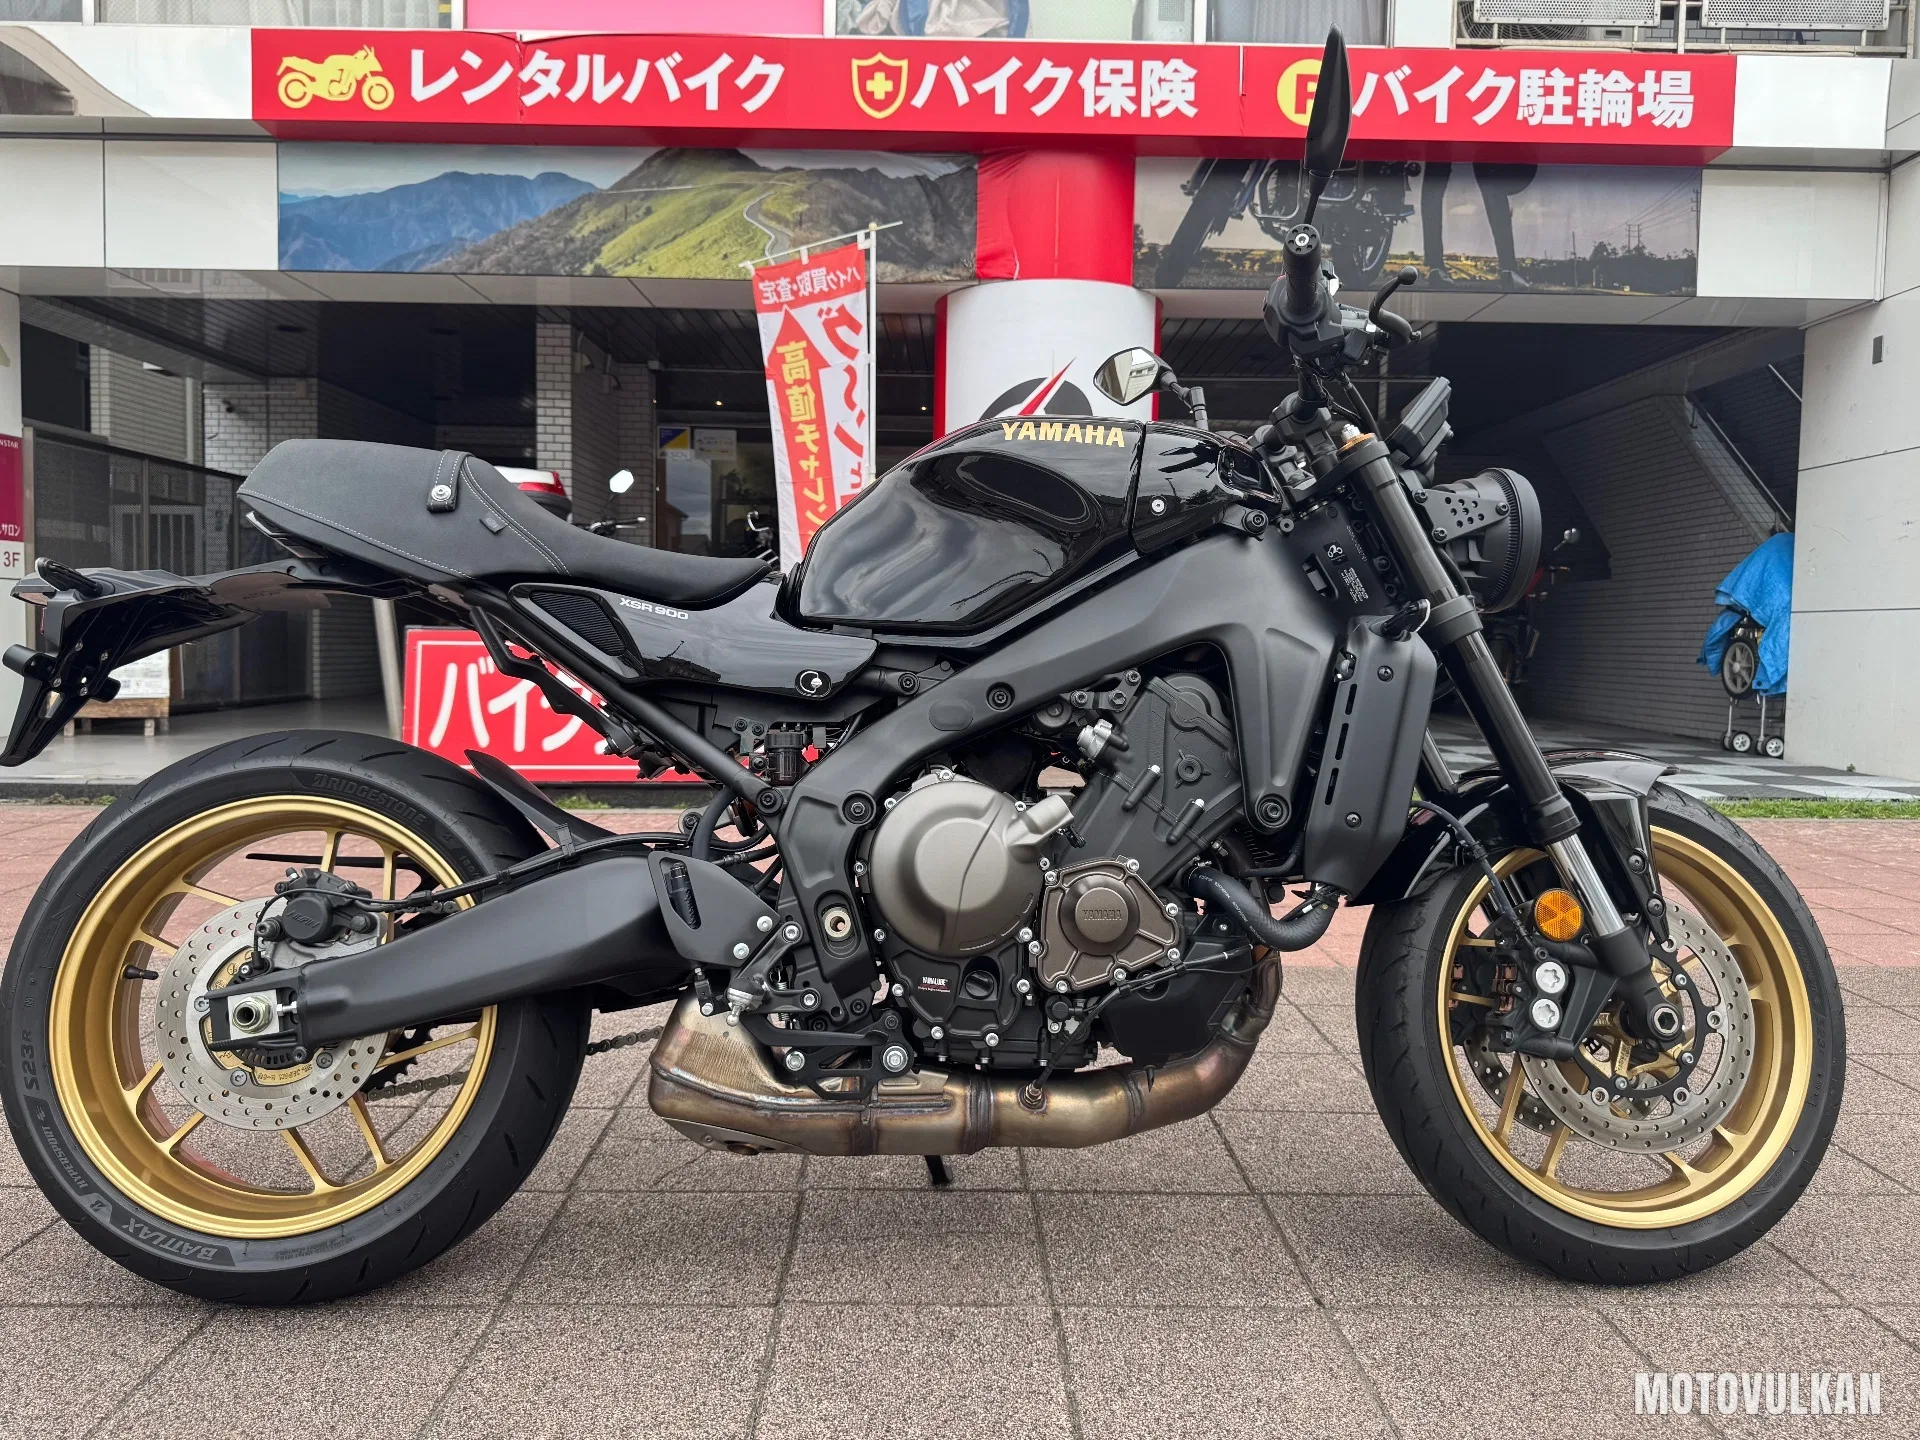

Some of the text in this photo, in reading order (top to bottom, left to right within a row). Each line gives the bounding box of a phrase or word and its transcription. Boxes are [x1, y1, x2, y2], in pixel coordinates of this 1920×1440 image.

[411, 48, 785, 114] レンタルバイク
[910, 55, 1199, 118] バイク保険
[1351, 64, 1694, 129] バイク駐輪場
[1002, 421, 1125, 448] YAMAHA
[3, 551, 20, 567] 3F
[620, 597, 689, 620] XSR 900
[312, 773, 427, 826] BRIDGESTONE
[1083, 909, 1122, 921] YAMAHA
[21, 1030, 218, 1261] BATTLAX HYPERSPORT S23R
